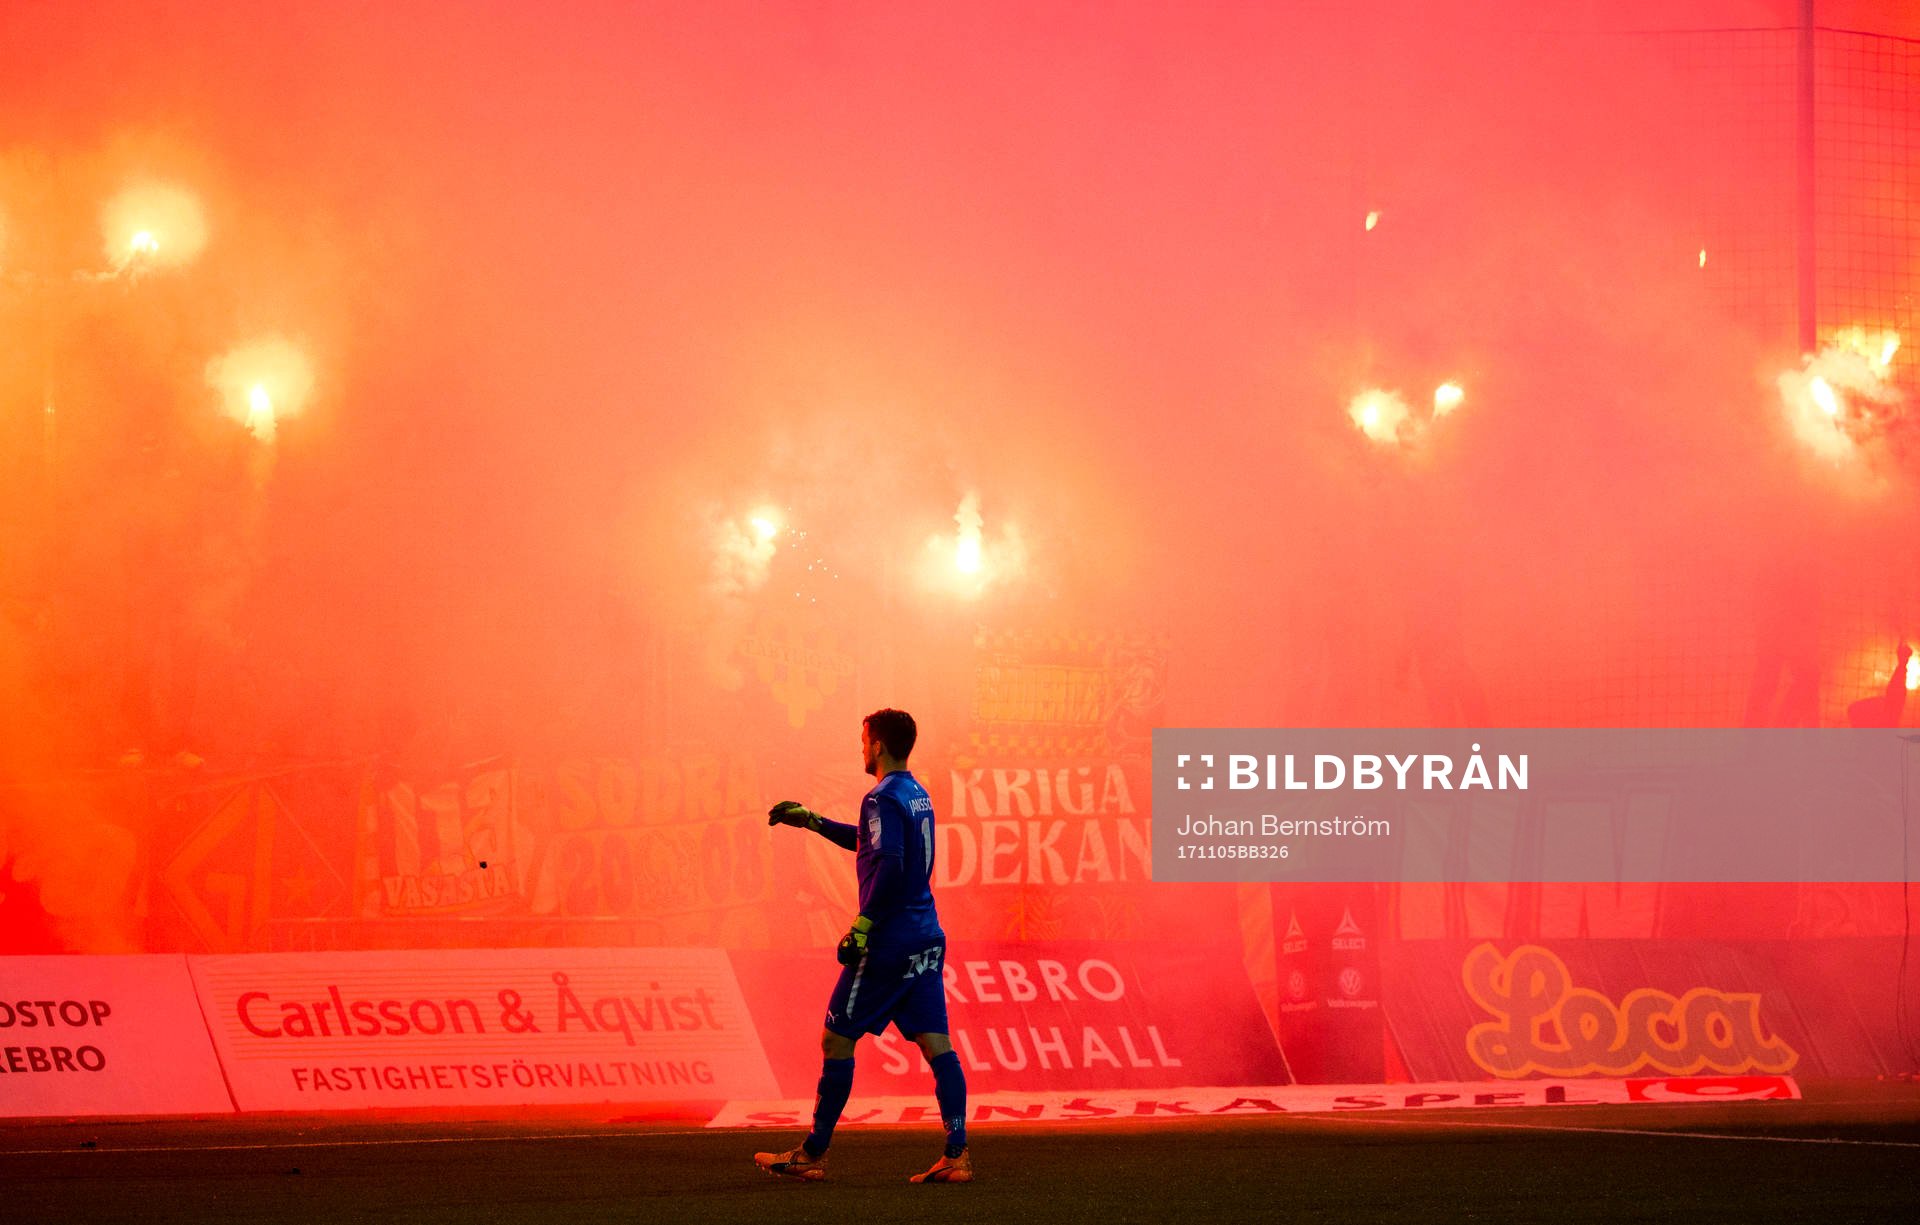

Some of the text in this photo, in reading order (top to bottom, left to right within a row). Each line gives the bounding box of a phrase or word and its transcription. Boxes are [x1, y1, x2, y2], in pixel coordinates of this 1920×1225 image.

[950, 764, 1136, 818] KRIGA
[943, 960, 1125, 1003] REBRO
[237, 972, 725, 1047] Carlsson & Åqvist
[1463, 942, 1800, 1078] Leca
[875, 1026, 1182, 1075] SLUHALL
[291, 1060, 715, 1092] FASTIGHETSFÖRVALTNING
[1333, 1086, 1600, 1110] SPEL
